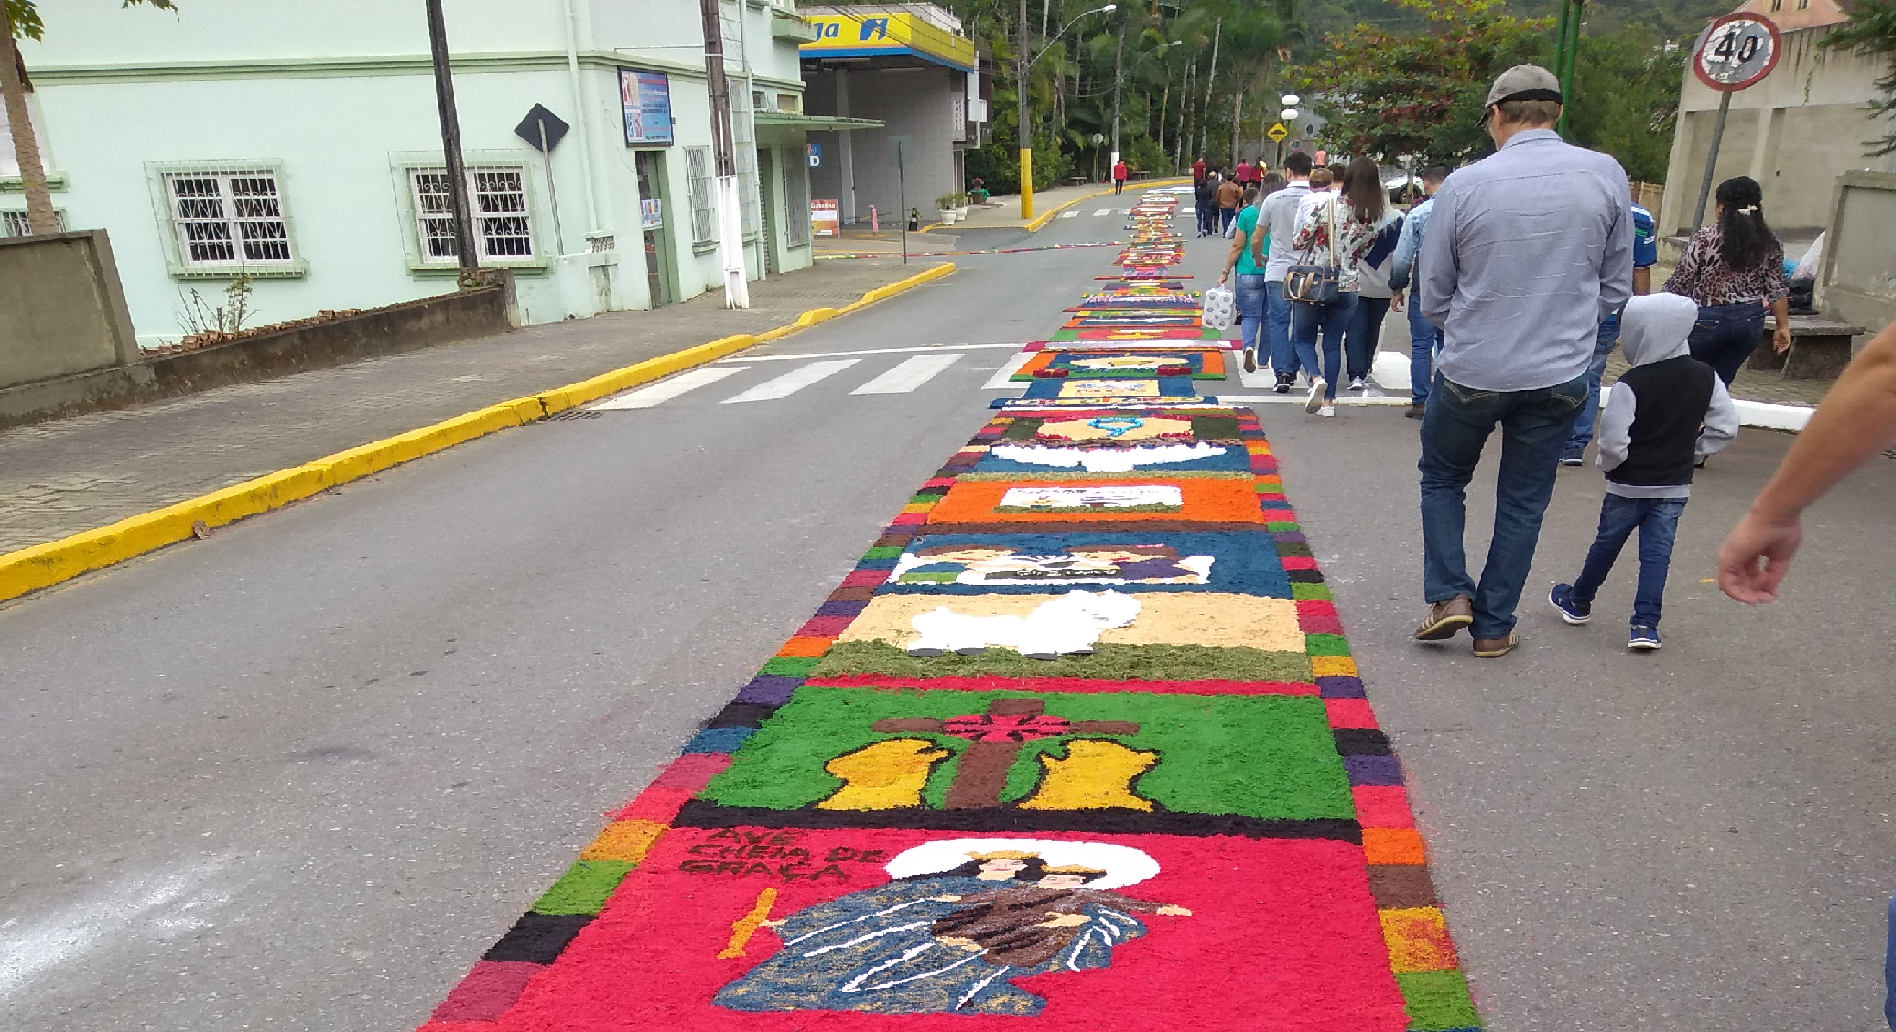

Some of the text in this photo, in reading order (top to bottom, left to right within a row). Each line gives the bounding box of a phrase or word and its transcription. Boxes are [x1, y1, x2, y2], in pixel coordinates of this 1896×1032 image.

[1714, 31, 1759, 63] 40
[707, 828, 806, 845] AVE
[687, 844, 886, 863] CHEIA DE
